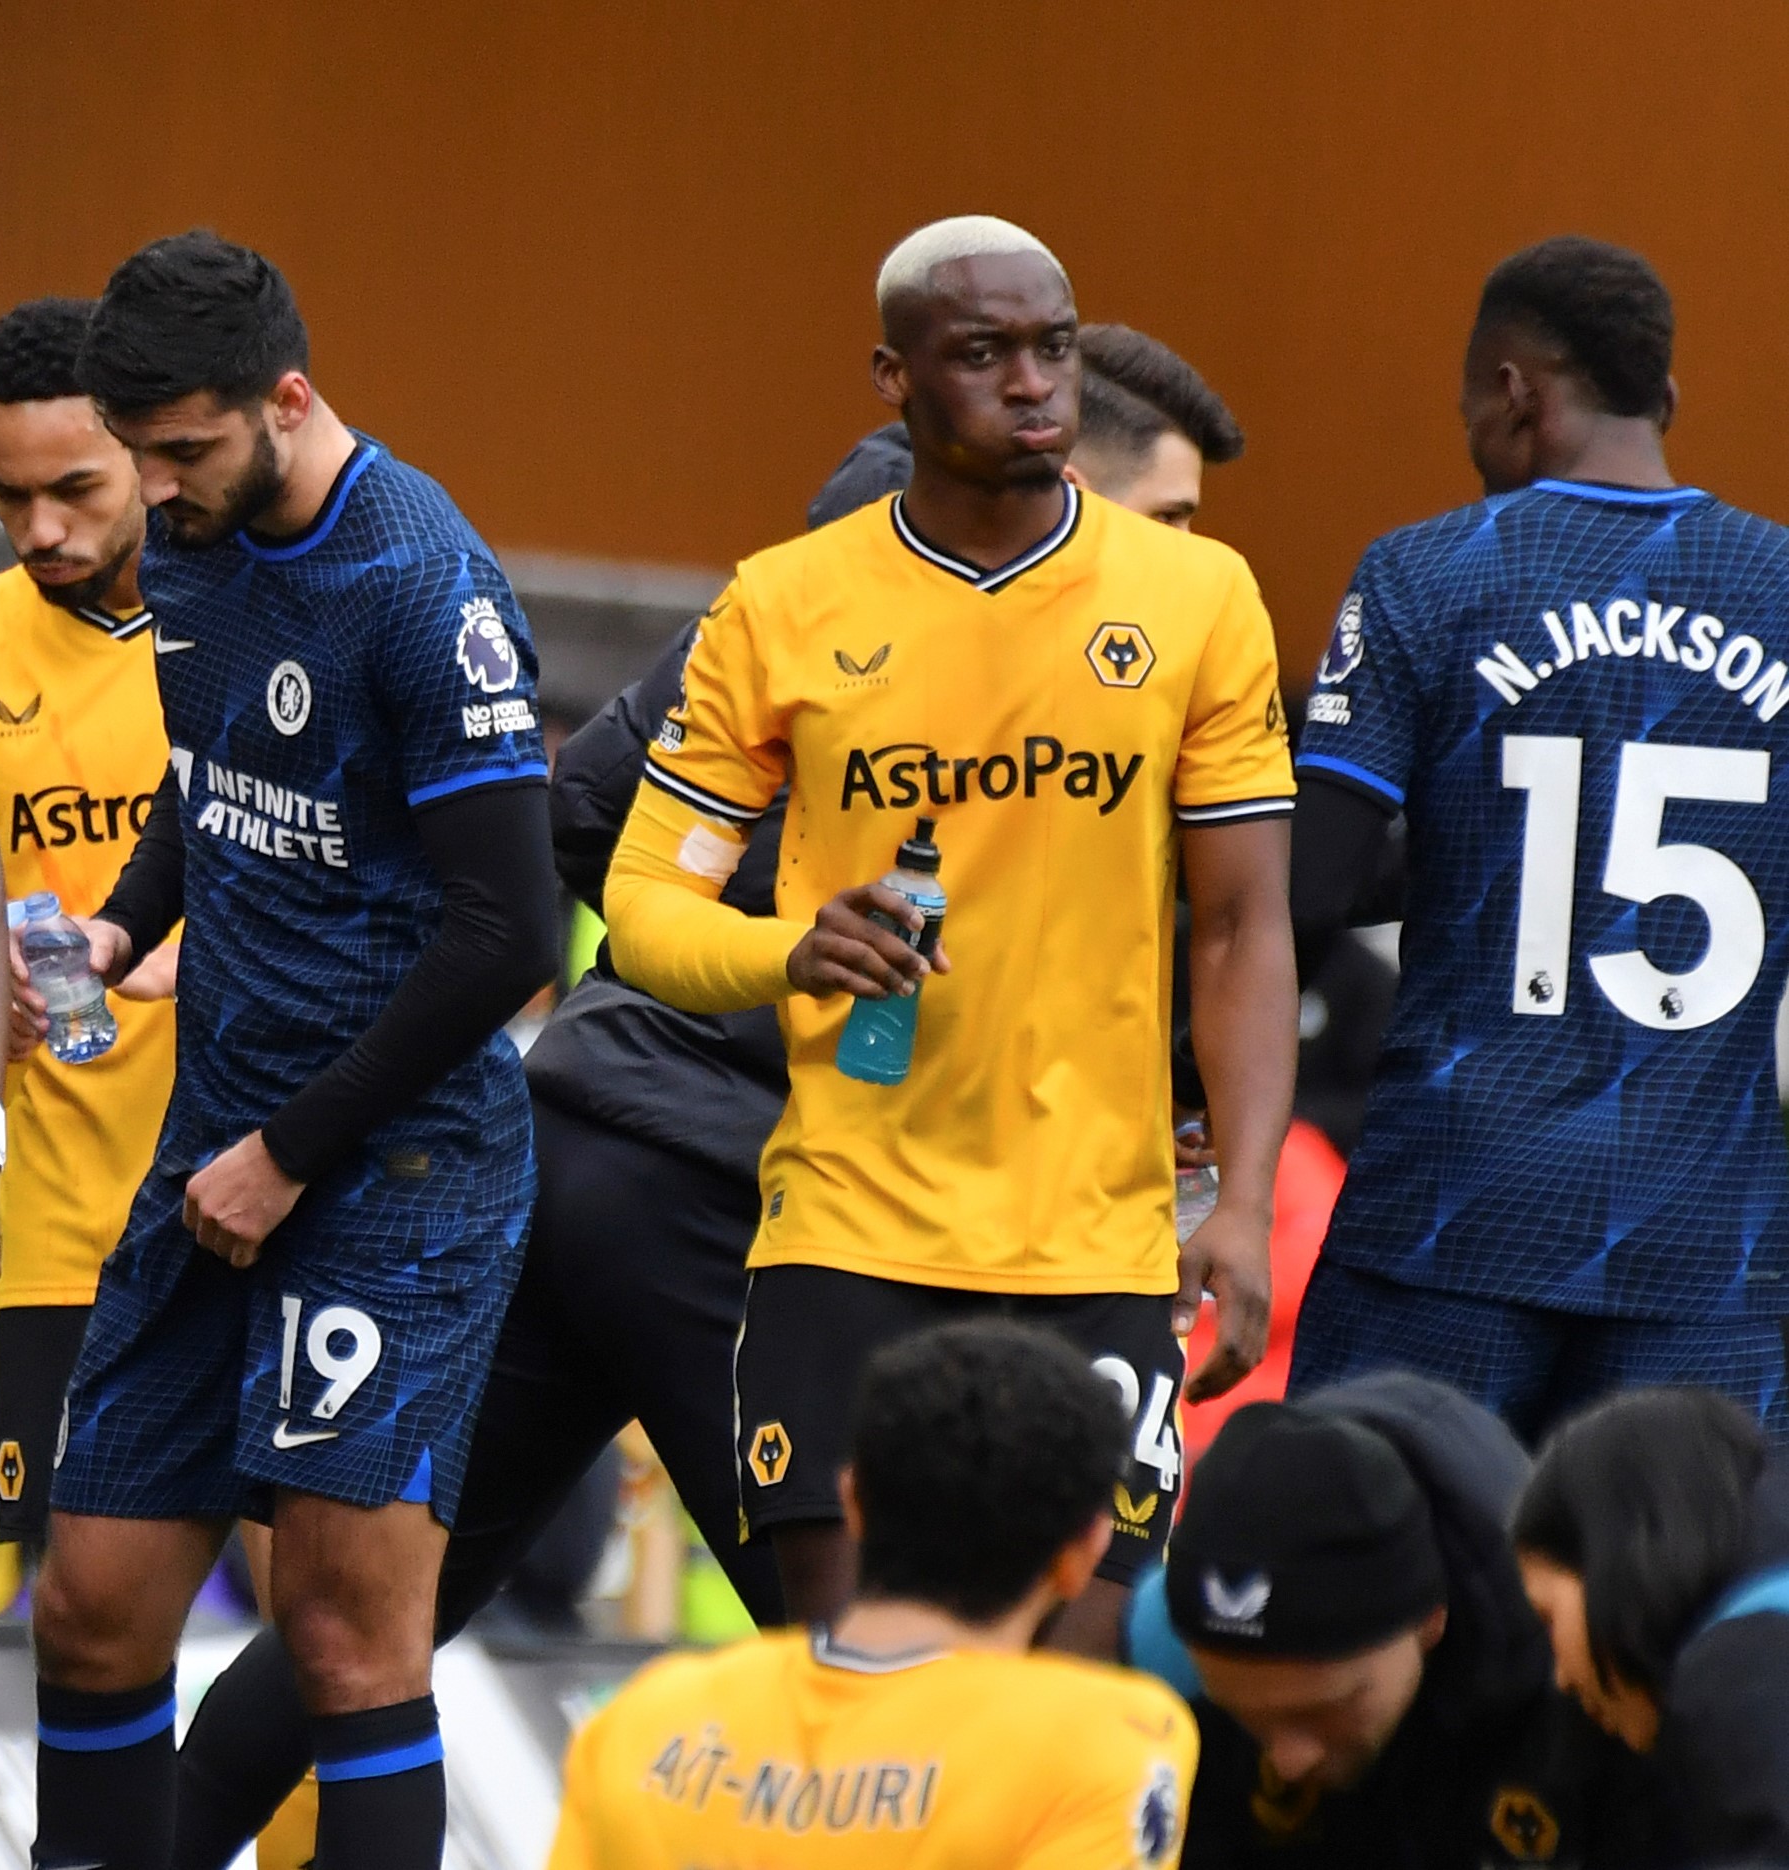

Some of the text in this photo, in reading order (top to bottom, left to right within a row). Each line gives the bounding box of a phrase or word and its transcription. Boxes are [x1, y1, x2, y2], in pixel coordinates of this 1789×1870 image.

[1475, 599, 1789, 723] N.JACKSON
[462, 699, 529, 722] No room
[207, 760, 343, 832] INFINITE
[841, 734, 1146, 817] AstroPay
[197, 800, 349, 868] ATHLETE
[1502, 734, 1771, 1032] 15
[280, 1296, 382, 1420] 19
